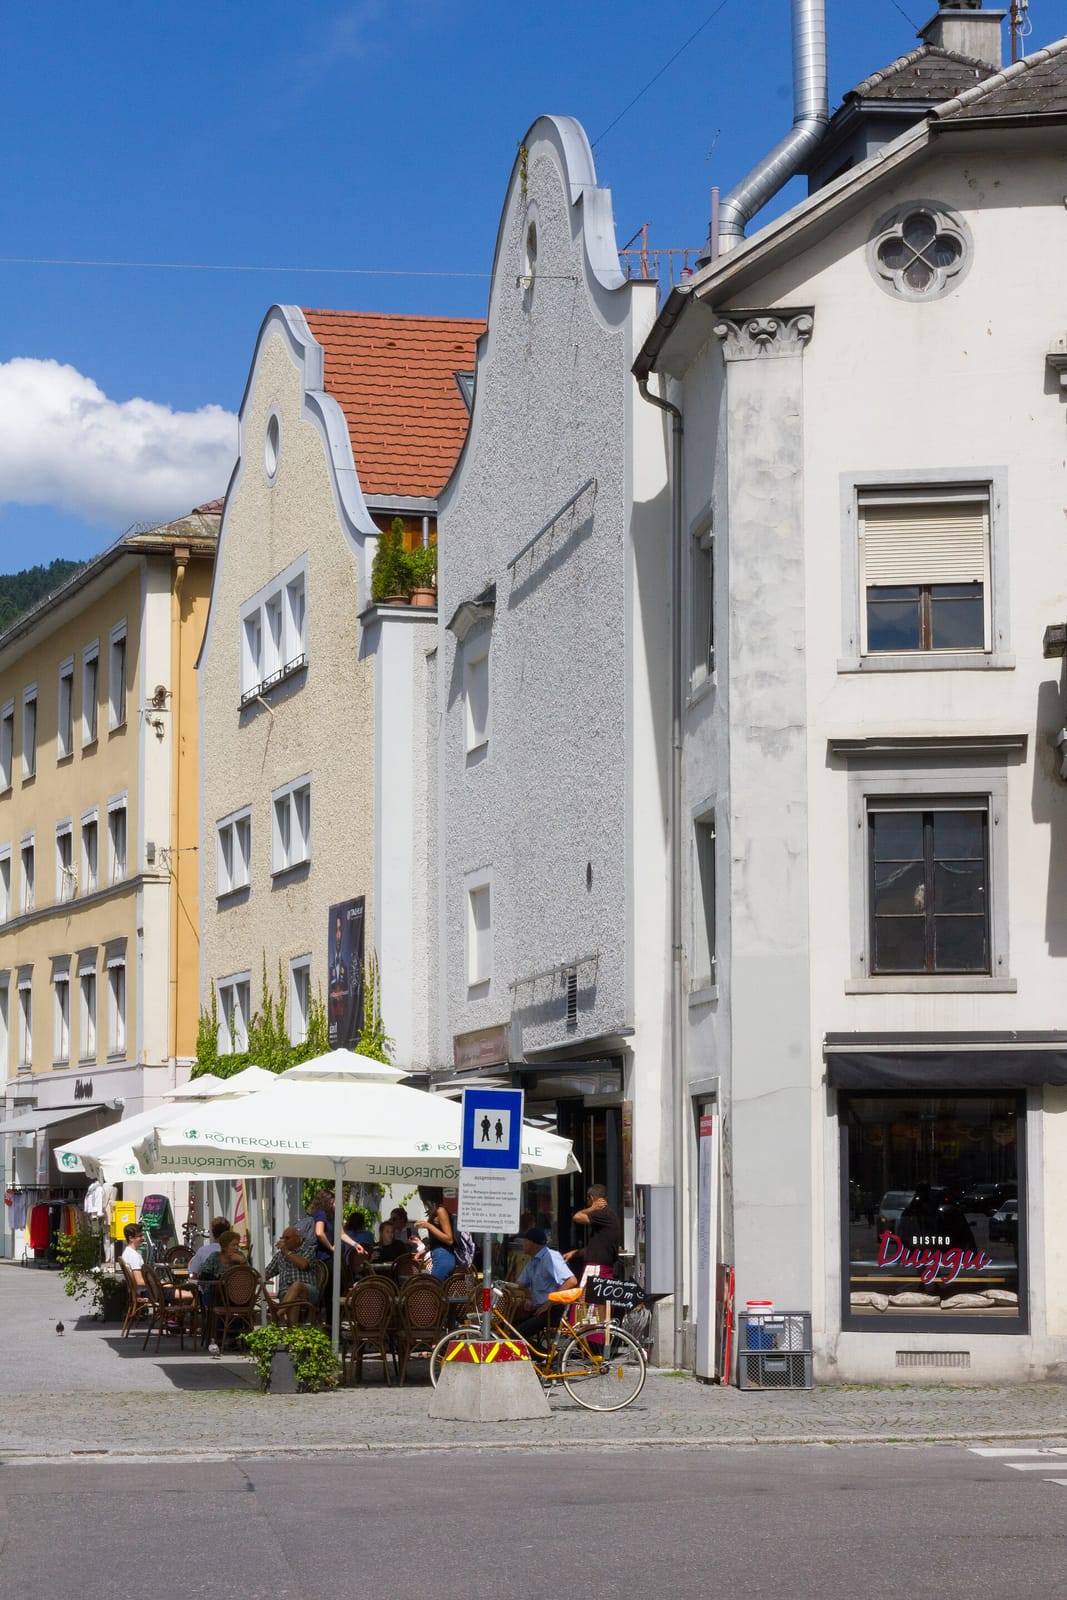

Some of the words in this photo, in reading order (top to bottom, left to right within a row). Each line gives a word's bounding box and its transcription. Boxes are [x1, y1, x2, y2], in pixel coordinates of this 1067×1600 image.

[912, 1236, 951, 1245] BISTRO
[878, 1230, 992, 1285] Duygu
[593, 1283, 624, 1298] 100
[624, 1292, 634, 1300] m
